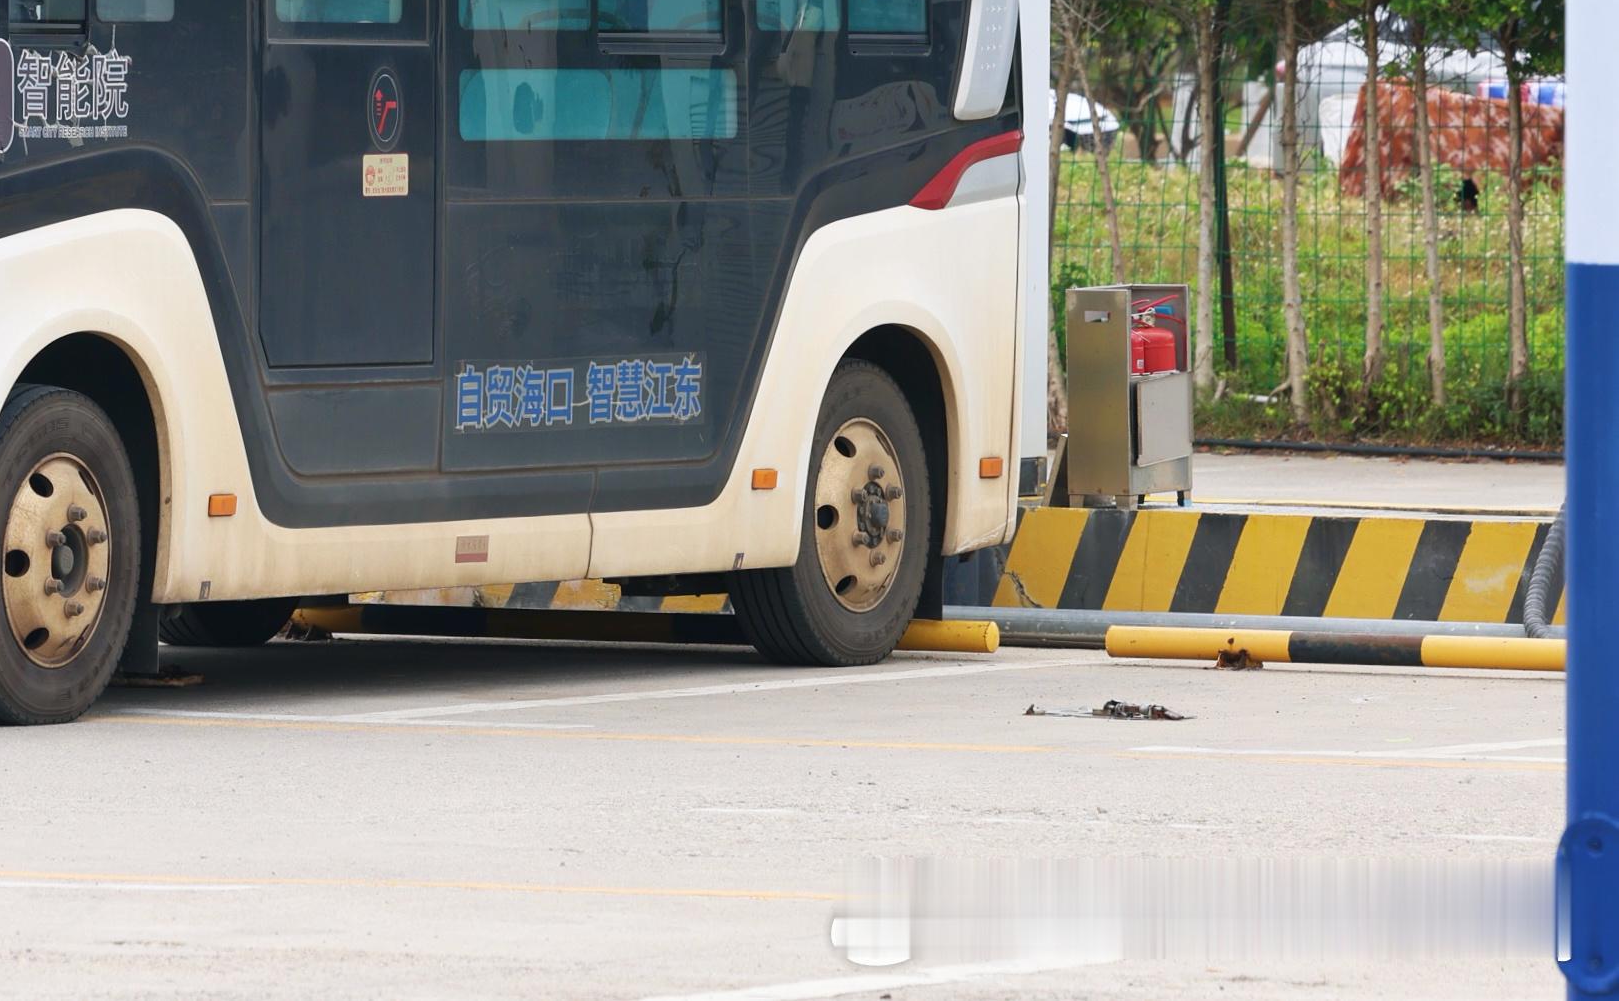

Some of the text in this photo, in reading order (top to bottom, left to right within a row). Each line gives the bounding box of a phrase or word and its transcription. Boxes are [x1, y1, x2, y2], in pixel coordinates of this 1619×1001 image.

[17, 49, 129, 120] 智能院
[42, 127, 58, 138] CITY
[456, 357, 702, 429] 自贸海口 智慧江东
